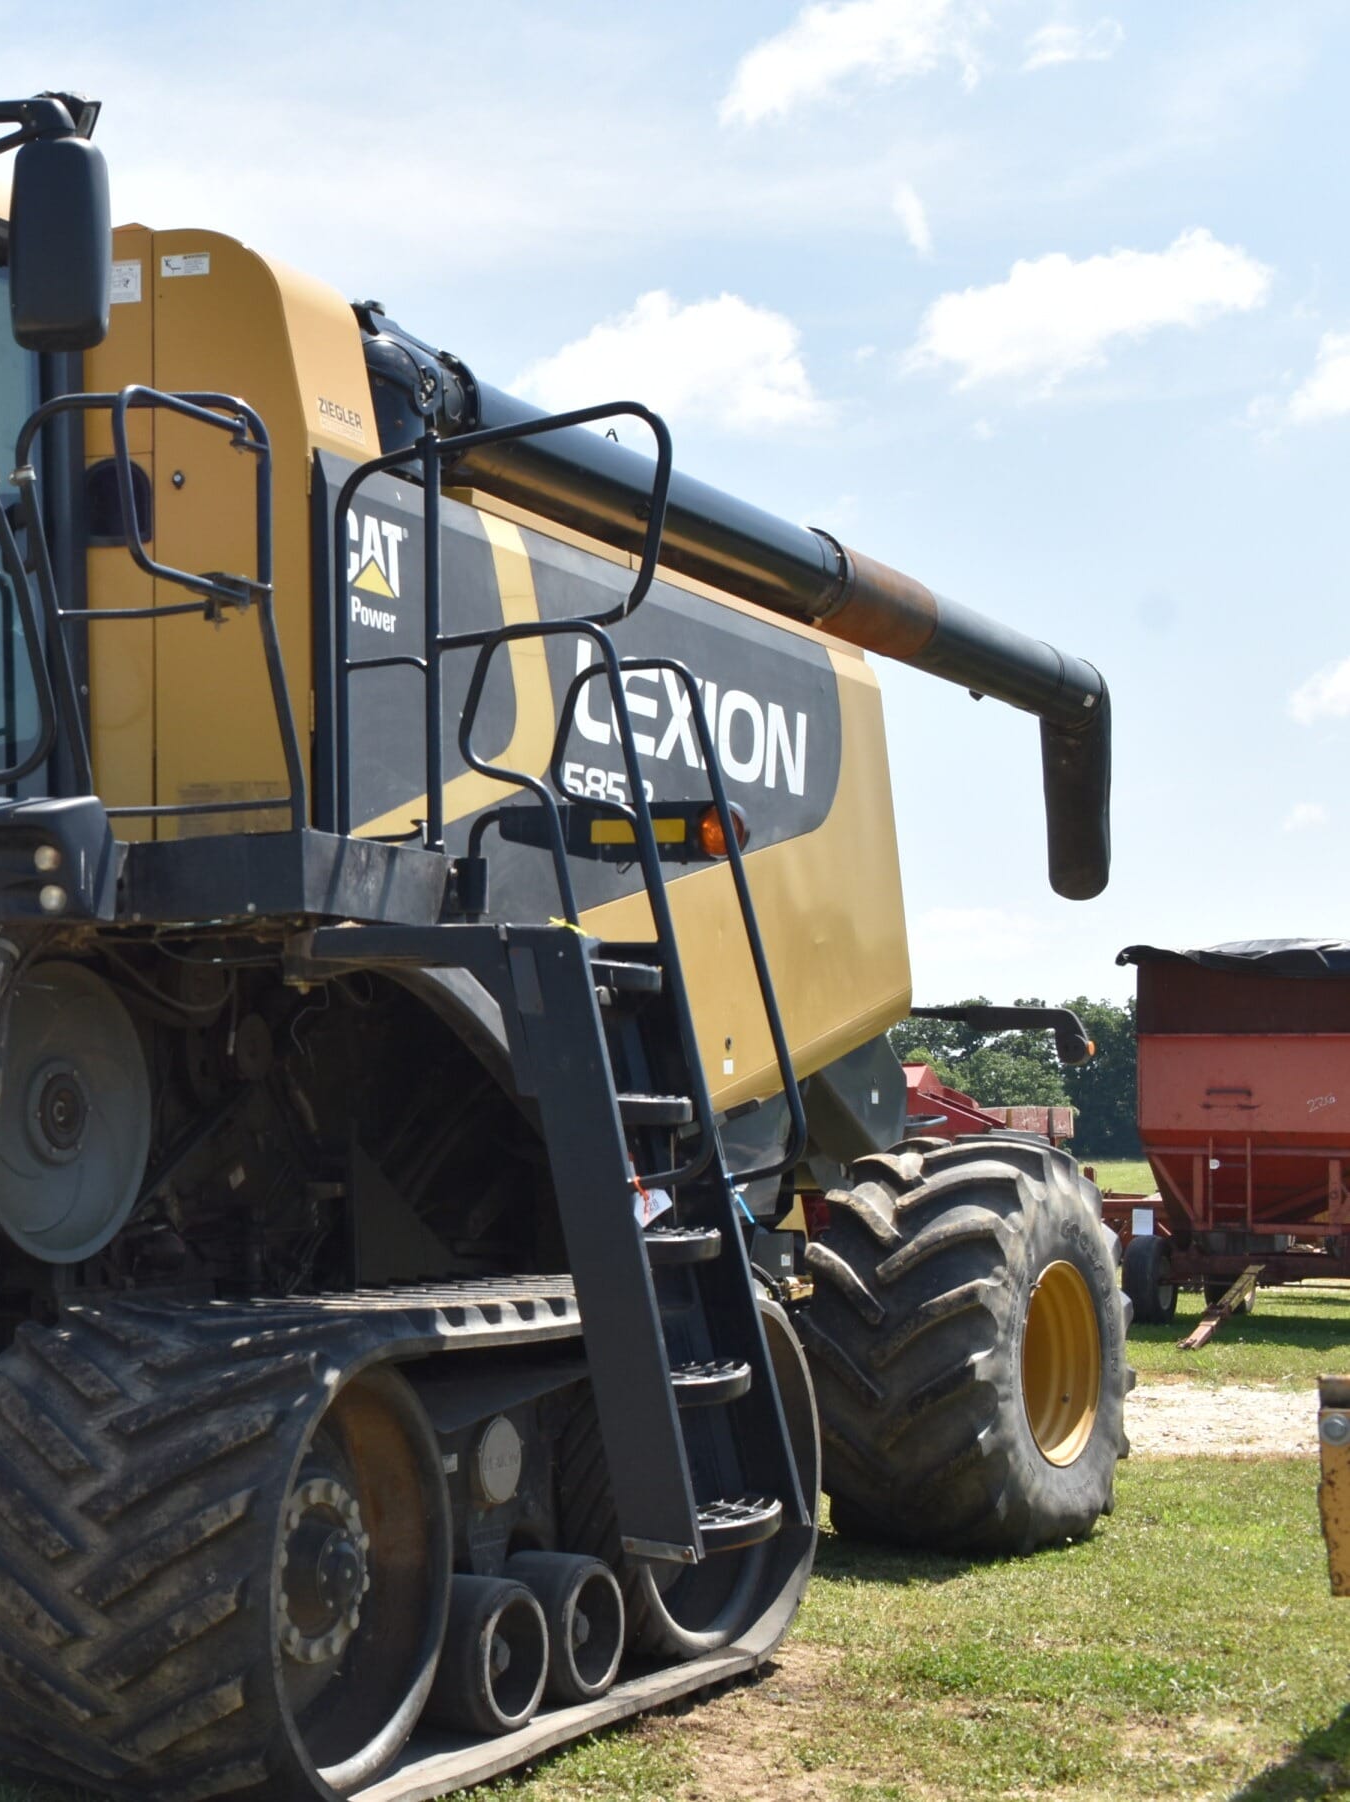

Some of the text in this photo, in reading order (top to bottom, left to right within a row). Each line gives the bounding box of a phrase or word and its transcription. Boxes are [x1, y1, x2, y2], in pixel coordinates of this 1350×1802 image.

[318, 397, 363, 429] ZIEGLER
[351, 595, 397, 633] Power
[574, 638, 807, 796] LEXION
